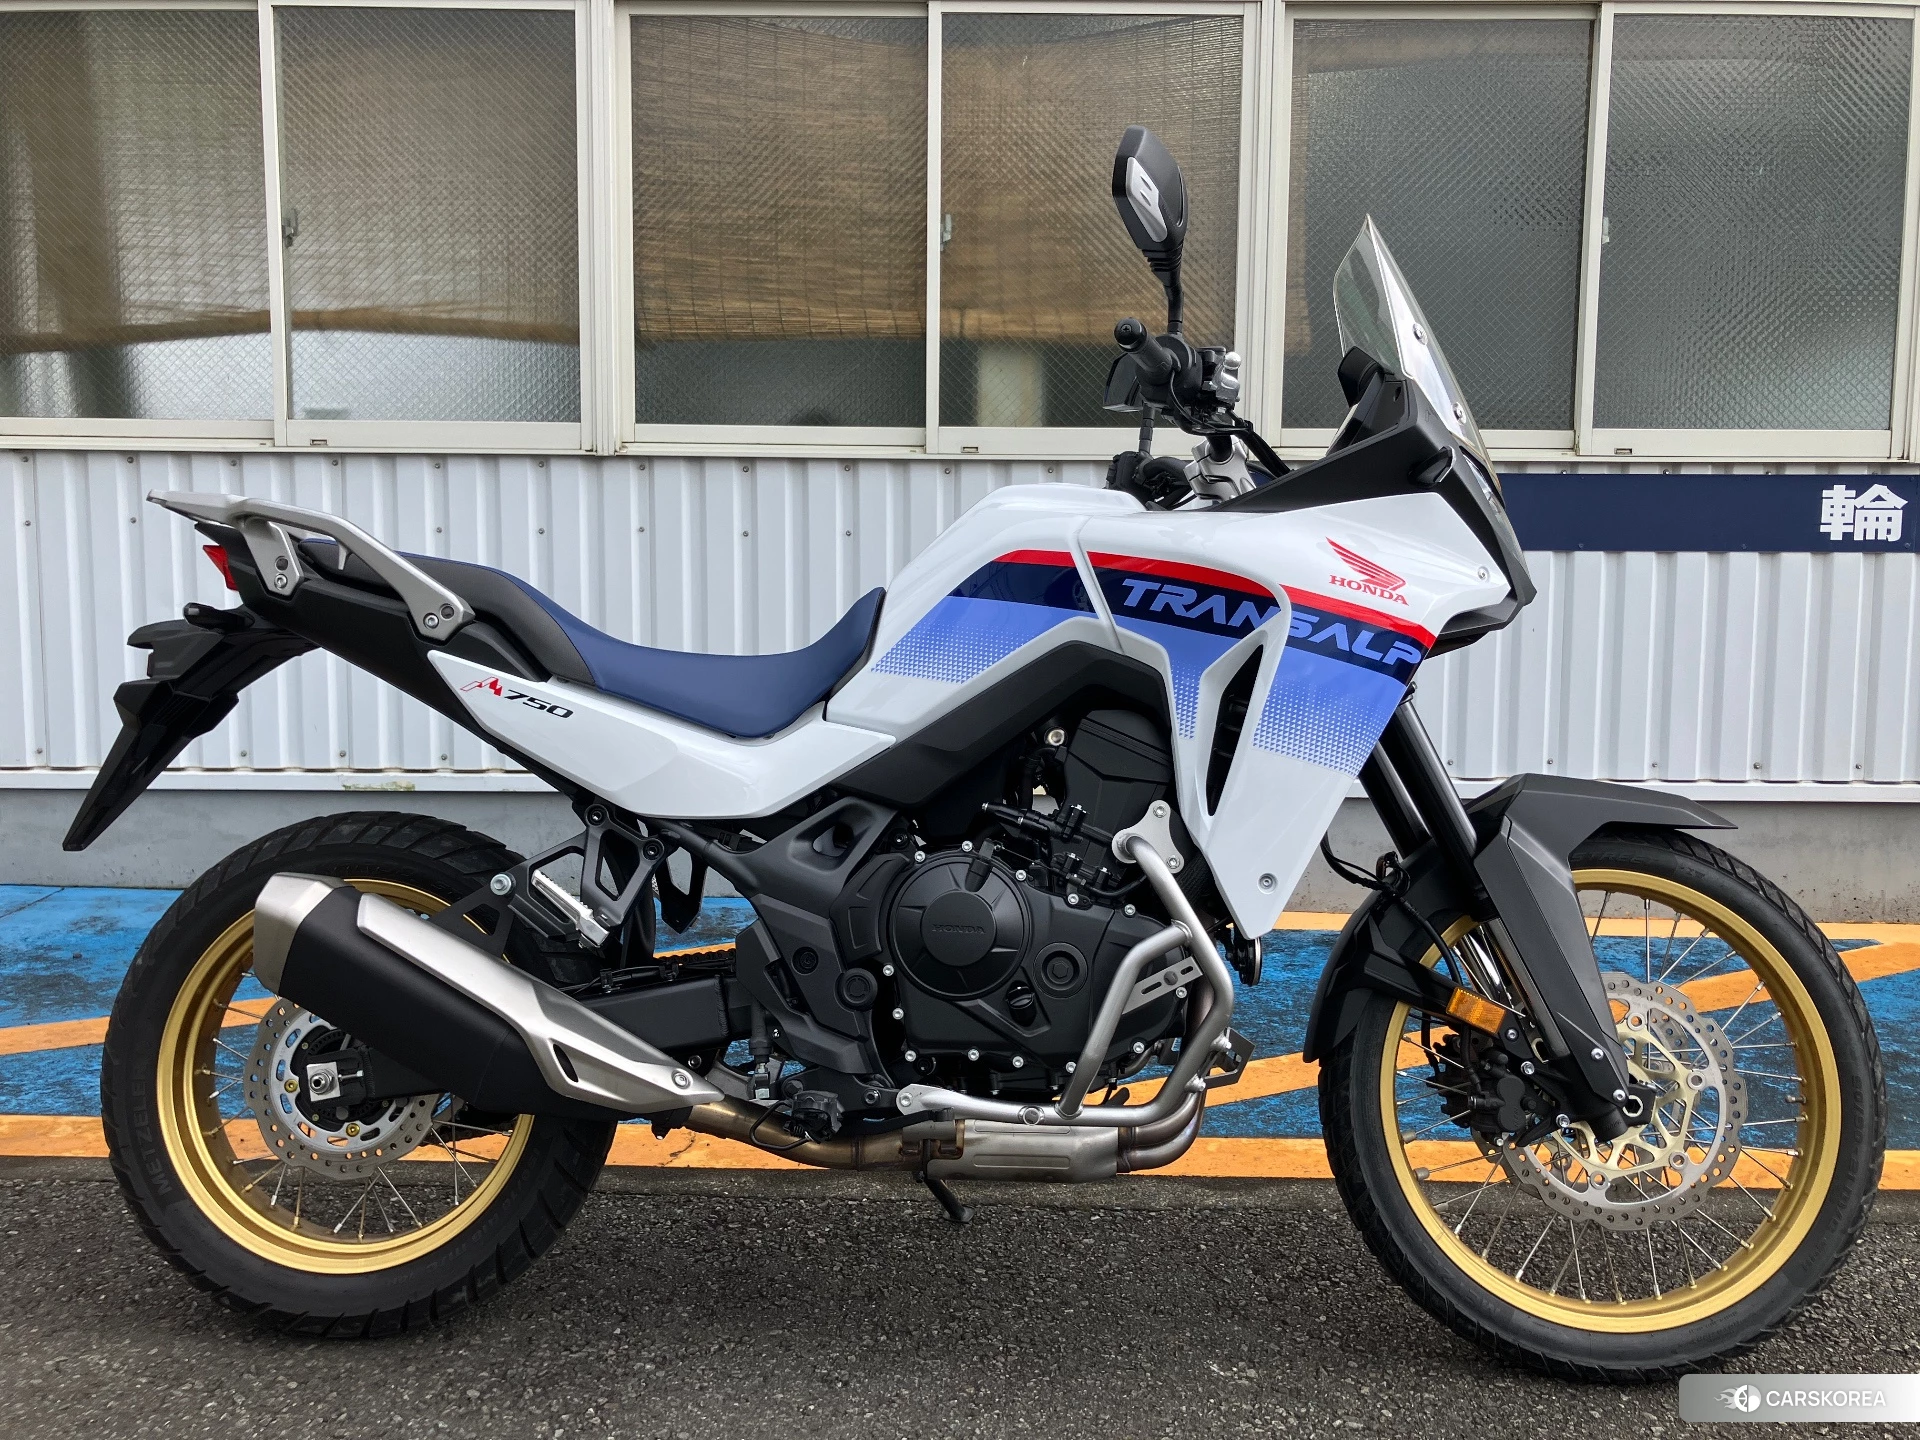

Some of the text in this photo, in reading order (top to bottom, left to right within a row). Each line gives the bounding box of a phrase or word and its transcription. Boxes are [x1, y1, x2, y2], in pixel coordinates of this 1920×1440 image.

[1820, 484, 1908, 542] 輪
[1329, 574, 1410, 606] HONDA
[1121, 578, 1422, 665] TRANSALP
[504, 689, 574, 718] 750
[931, 923, 986, 936] HONDA
